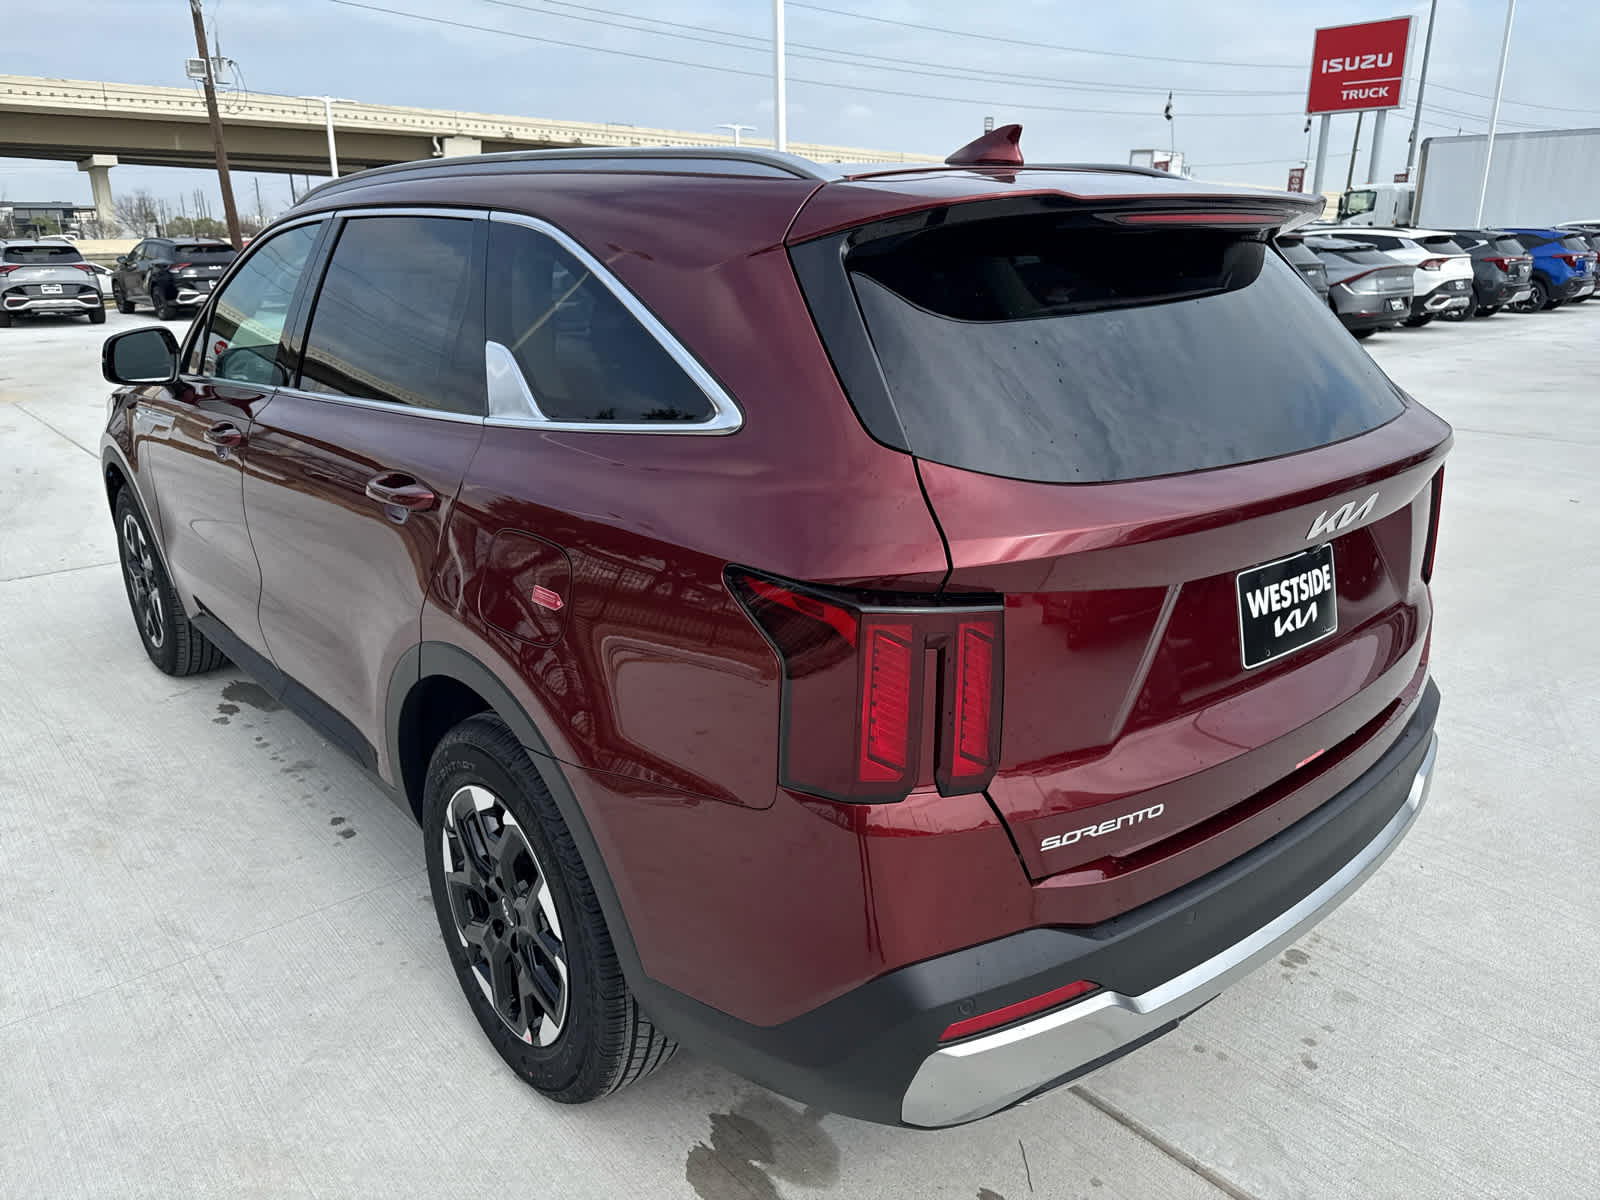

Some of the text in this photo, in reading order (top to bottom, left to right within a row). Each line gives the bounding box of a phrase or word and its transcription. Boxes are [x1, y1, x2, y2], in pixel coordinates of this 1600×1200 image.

[1321, 52, 1393, 74] ISUZU
[1341, 86, 1390, 101] TRUCK
[1246, 564, 1331, 619] WESTSIDE
[1040, 803, 1164, 851] SORENTO
